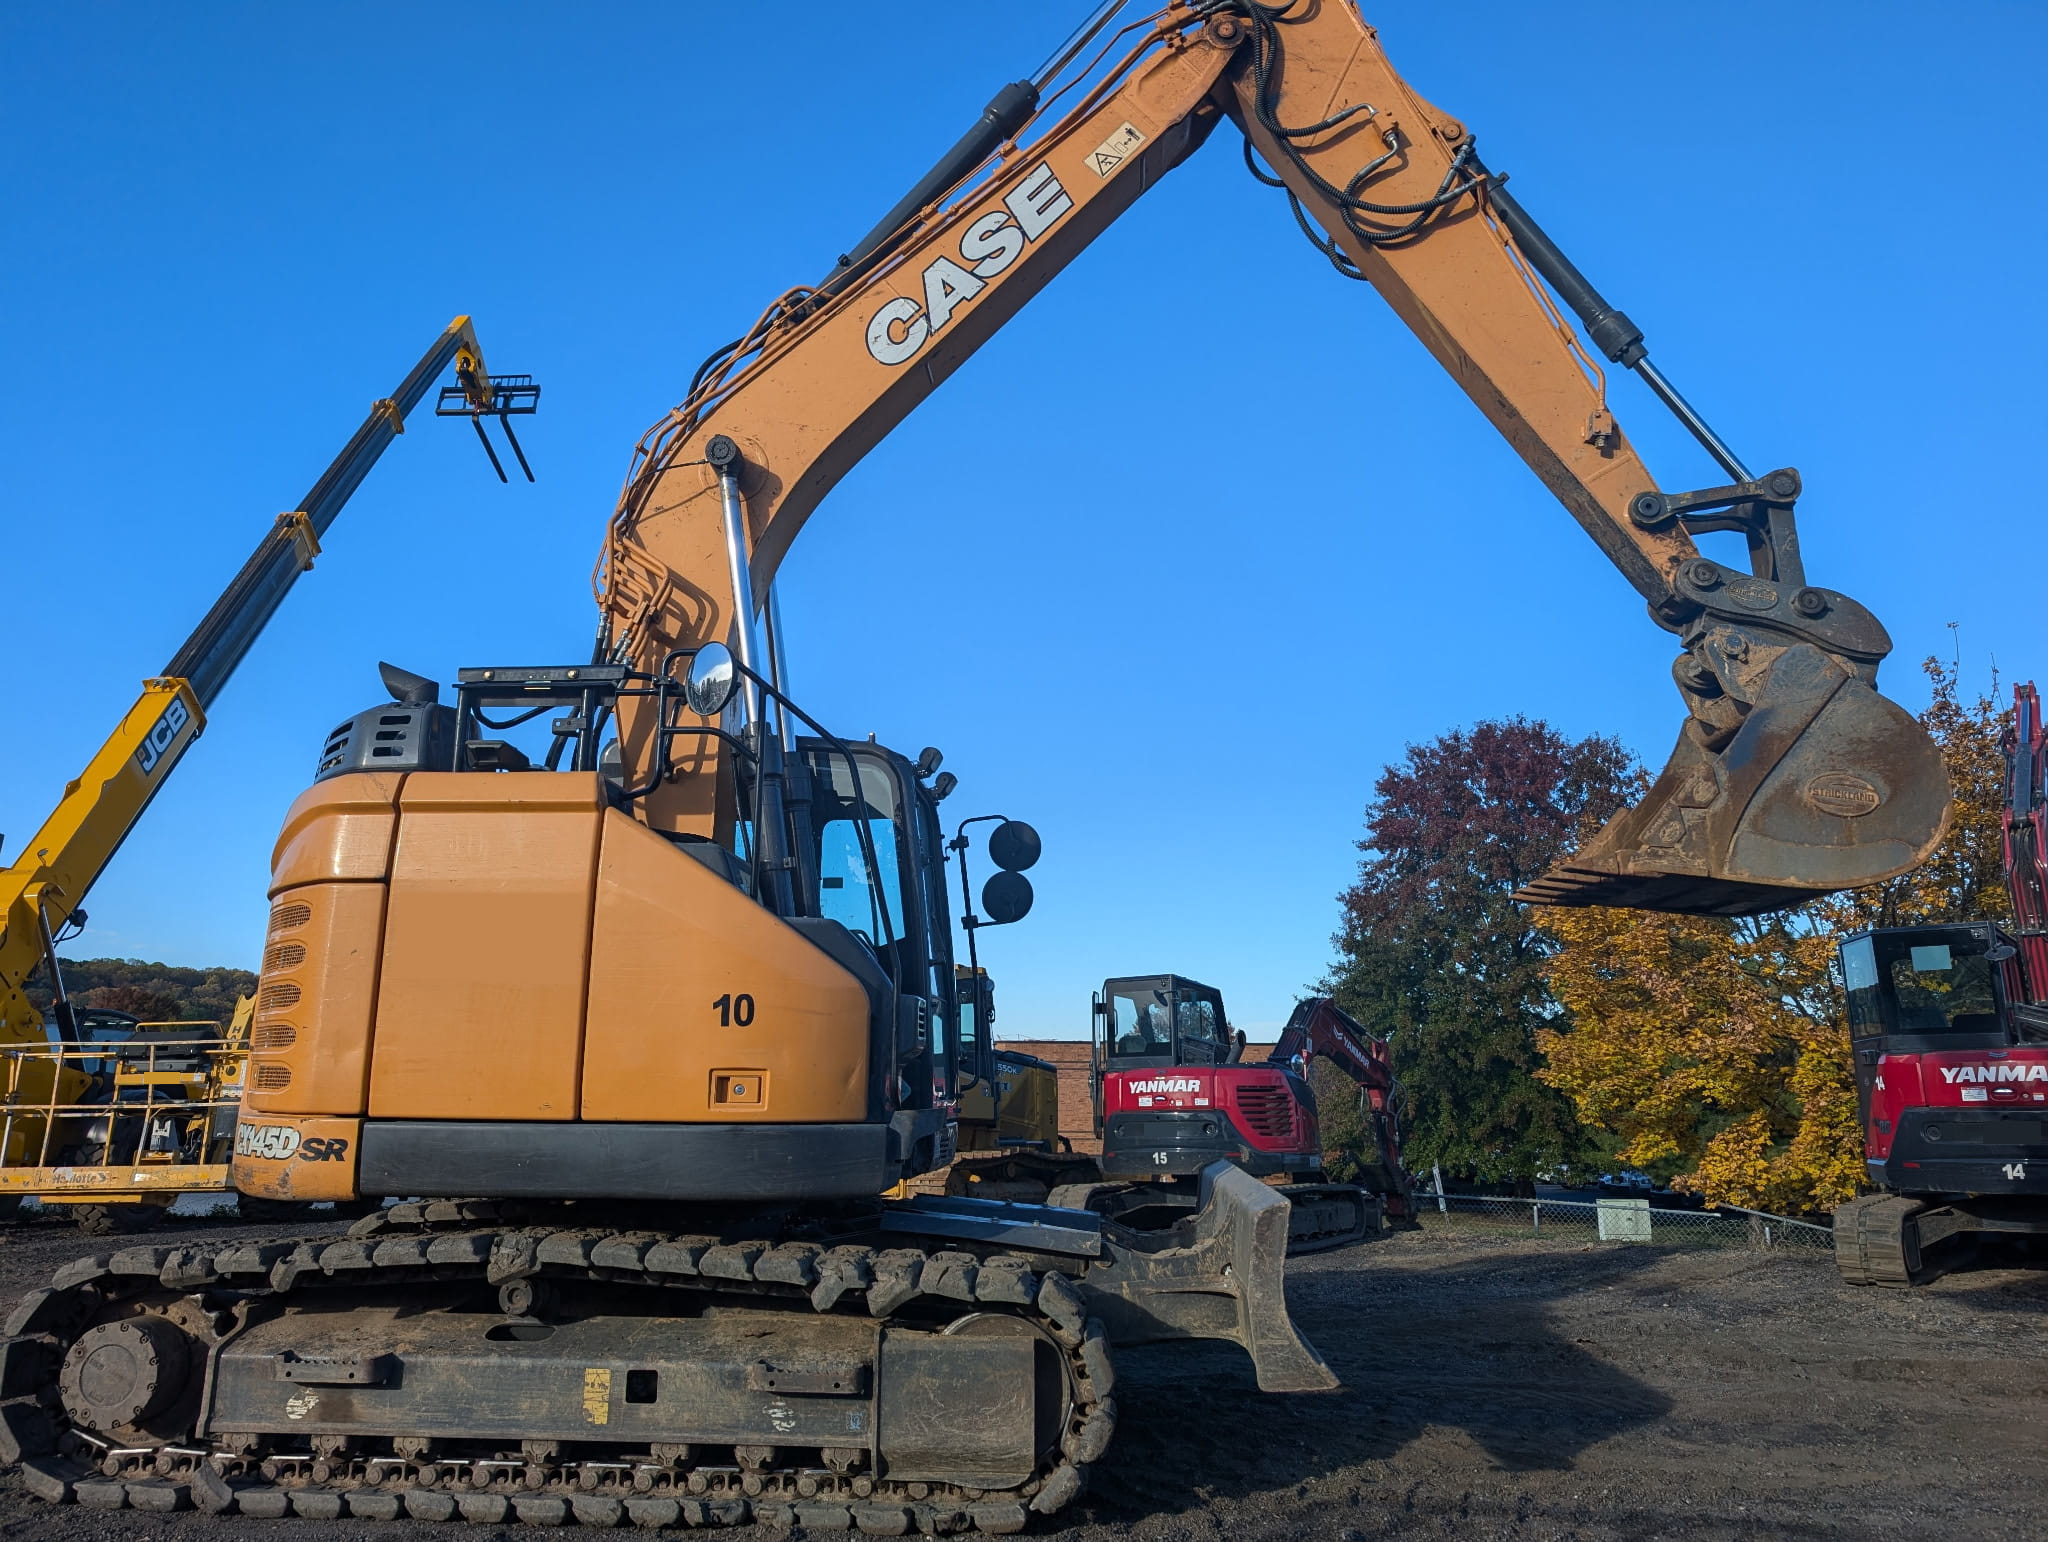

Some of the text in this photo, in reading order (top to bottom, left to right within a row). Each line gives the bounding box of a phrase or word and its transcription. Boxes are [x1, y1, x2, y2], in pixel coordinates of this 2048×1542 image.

[865, 160, 1075, 366] CASE
[142, 699, 187, 772] JCB
[1811, 786, 1876, 802] STRICKLAND
[712, 993, 755, 1027] 10
[1343, 1035, 1370, 1069] YANMAR
[997, 1063, 1017, 1075] 550K
[1128, 1079, 1201, 1094] YANMAR
[1875, 1075, 1886, 1091] 14
[299, 1137, 349, 1162] SR
[1152, 1151, 1168, 1165] 15
[2002, 1163, 2026, 1180] 14
